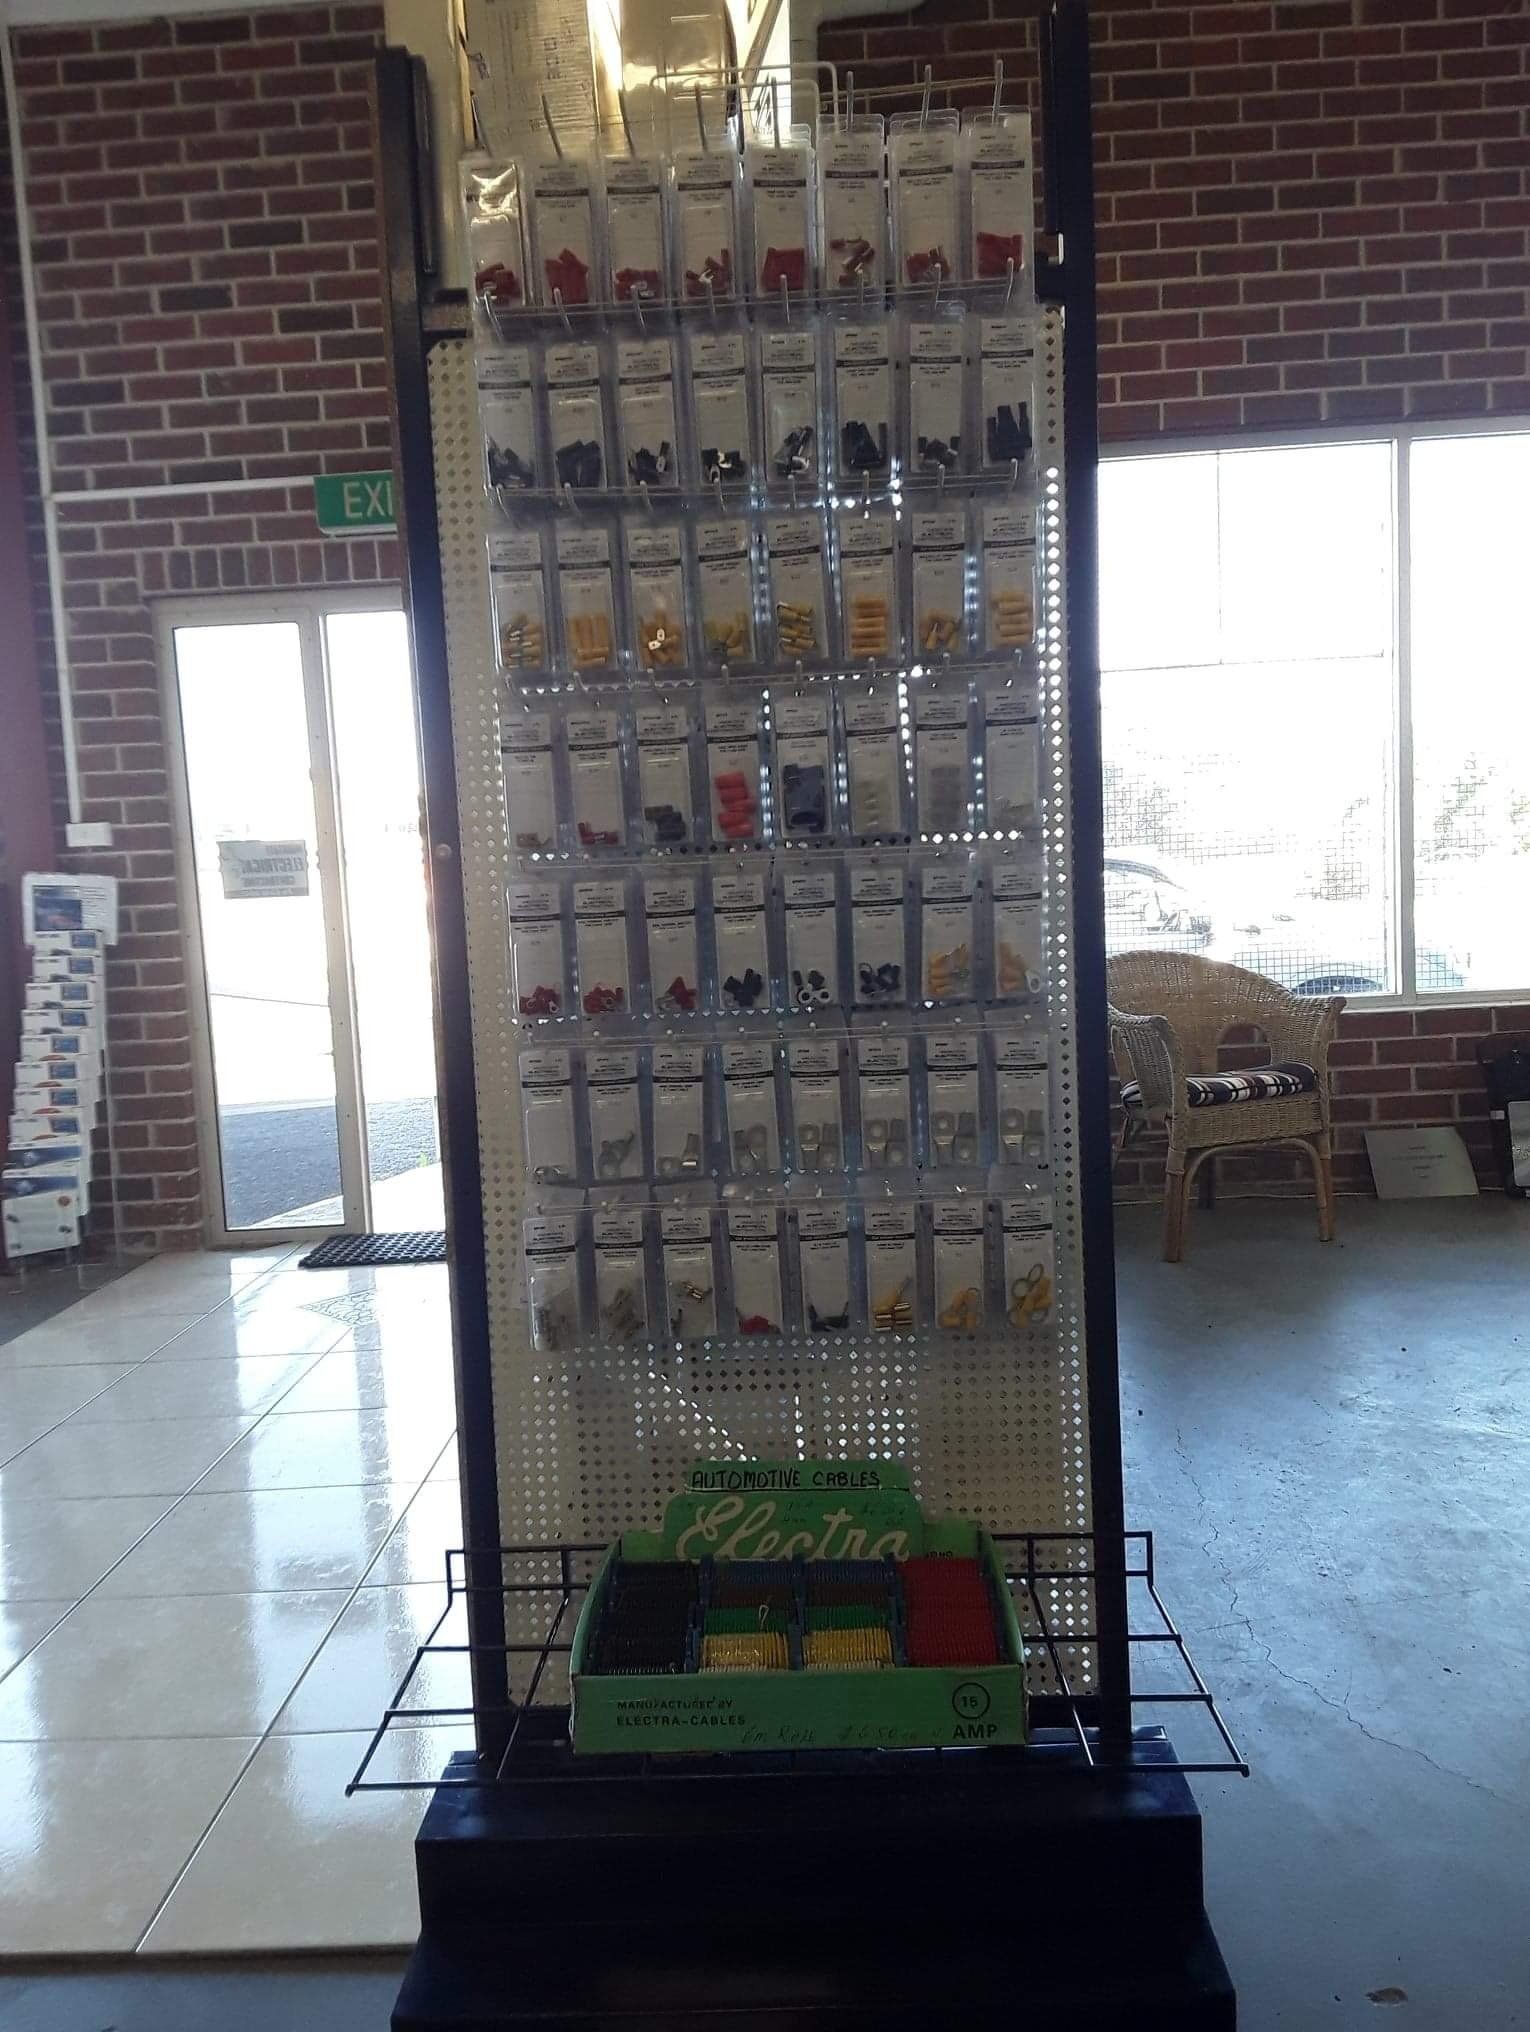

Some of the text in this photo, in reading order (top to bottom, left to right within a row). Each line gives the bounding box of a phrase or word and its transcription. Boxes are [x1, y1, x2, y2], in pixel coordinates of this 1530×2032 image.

[343, 480, 393, 519] EXI
[692, 1469, 880, 1490] AUTOMOTIVE CABLES
[676, 1495, 910, 1562] Electra
[718, 1699, 734, 1709] BY
[617, 1714, 746, 1727] ELECTRA-CABLES
[952, 1724, 998, 1739] AMP
